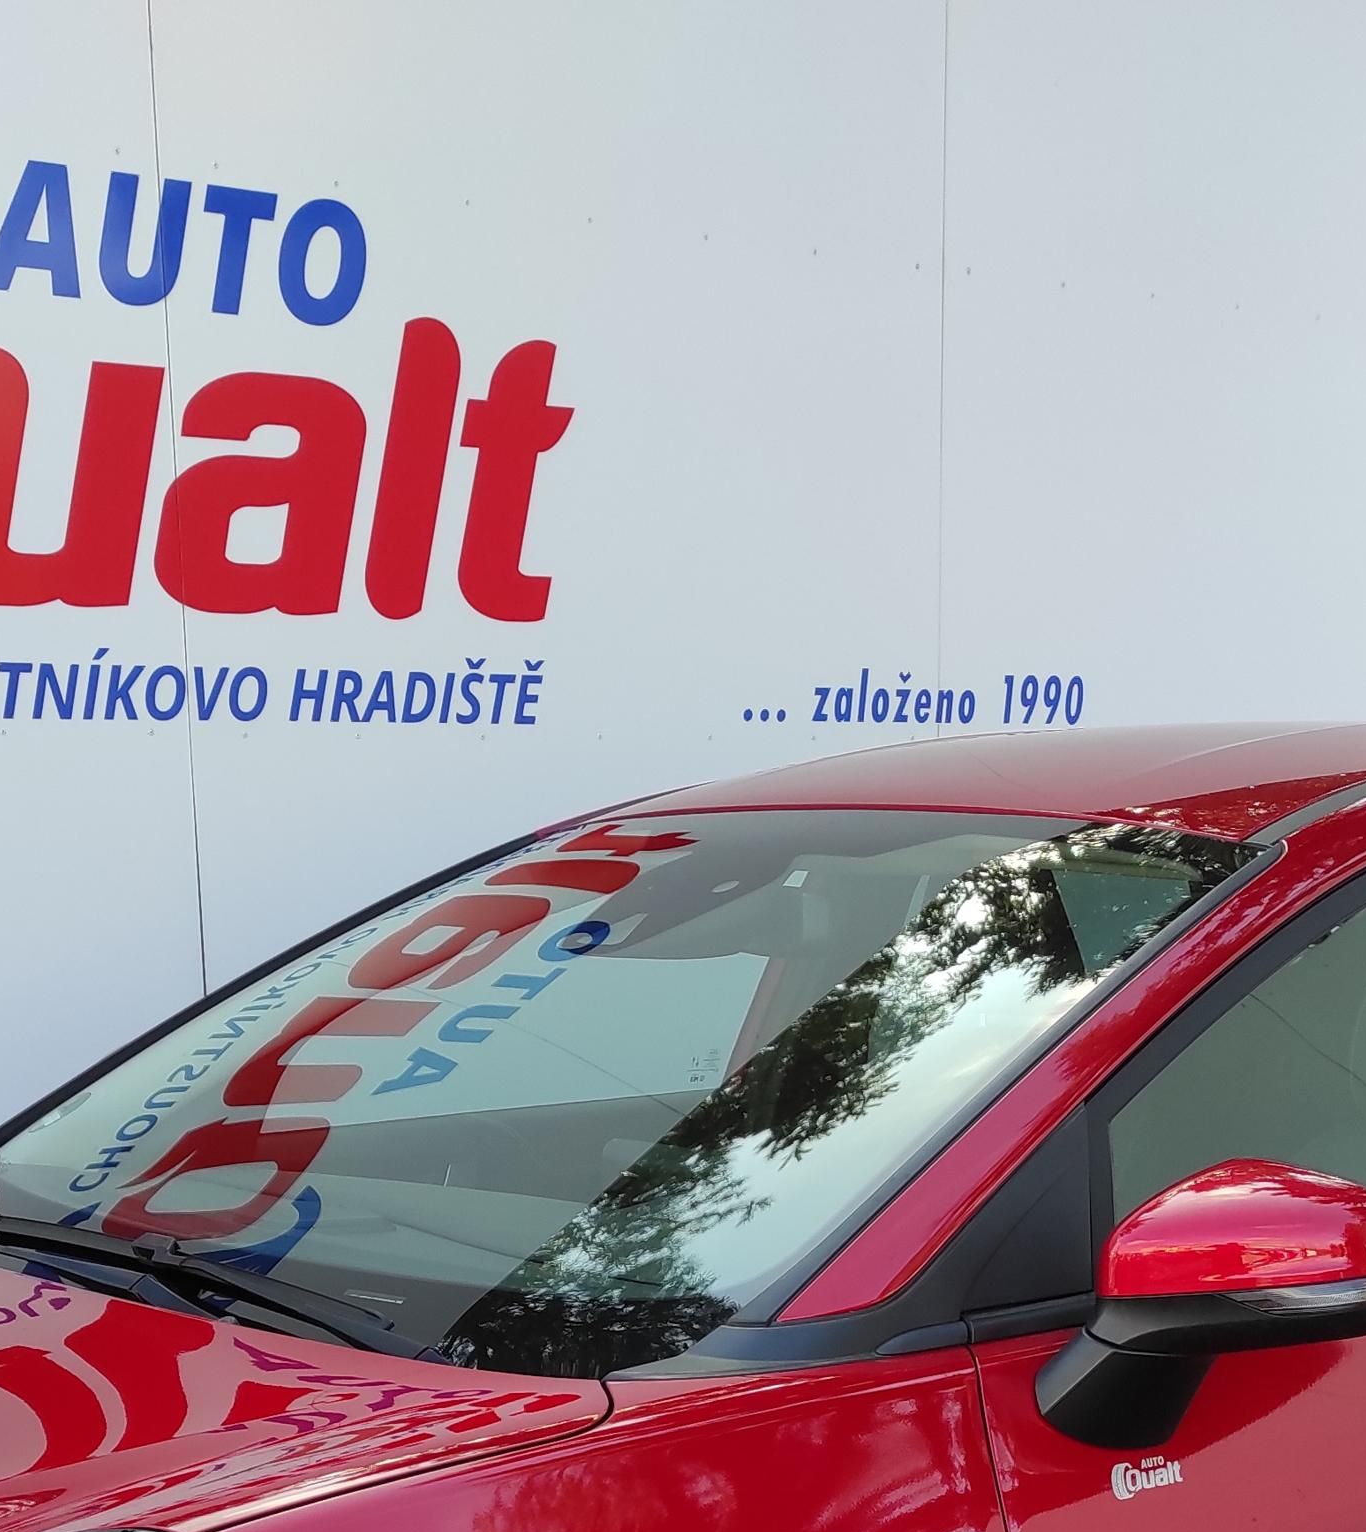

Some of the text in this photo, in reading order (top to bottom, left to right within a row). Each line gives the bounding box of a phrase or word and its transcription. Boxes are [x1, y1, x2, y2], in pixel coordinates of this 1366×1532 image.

[288, 657, 544, 727] HRADIŠTĚ
[812, 668, 976, 724] založeno
[1003, 675, 1084, 726] 1990
[1124, 1460, 1184, 1493] Qualt
[1141, 1455, 1165, 1469] AUTO
